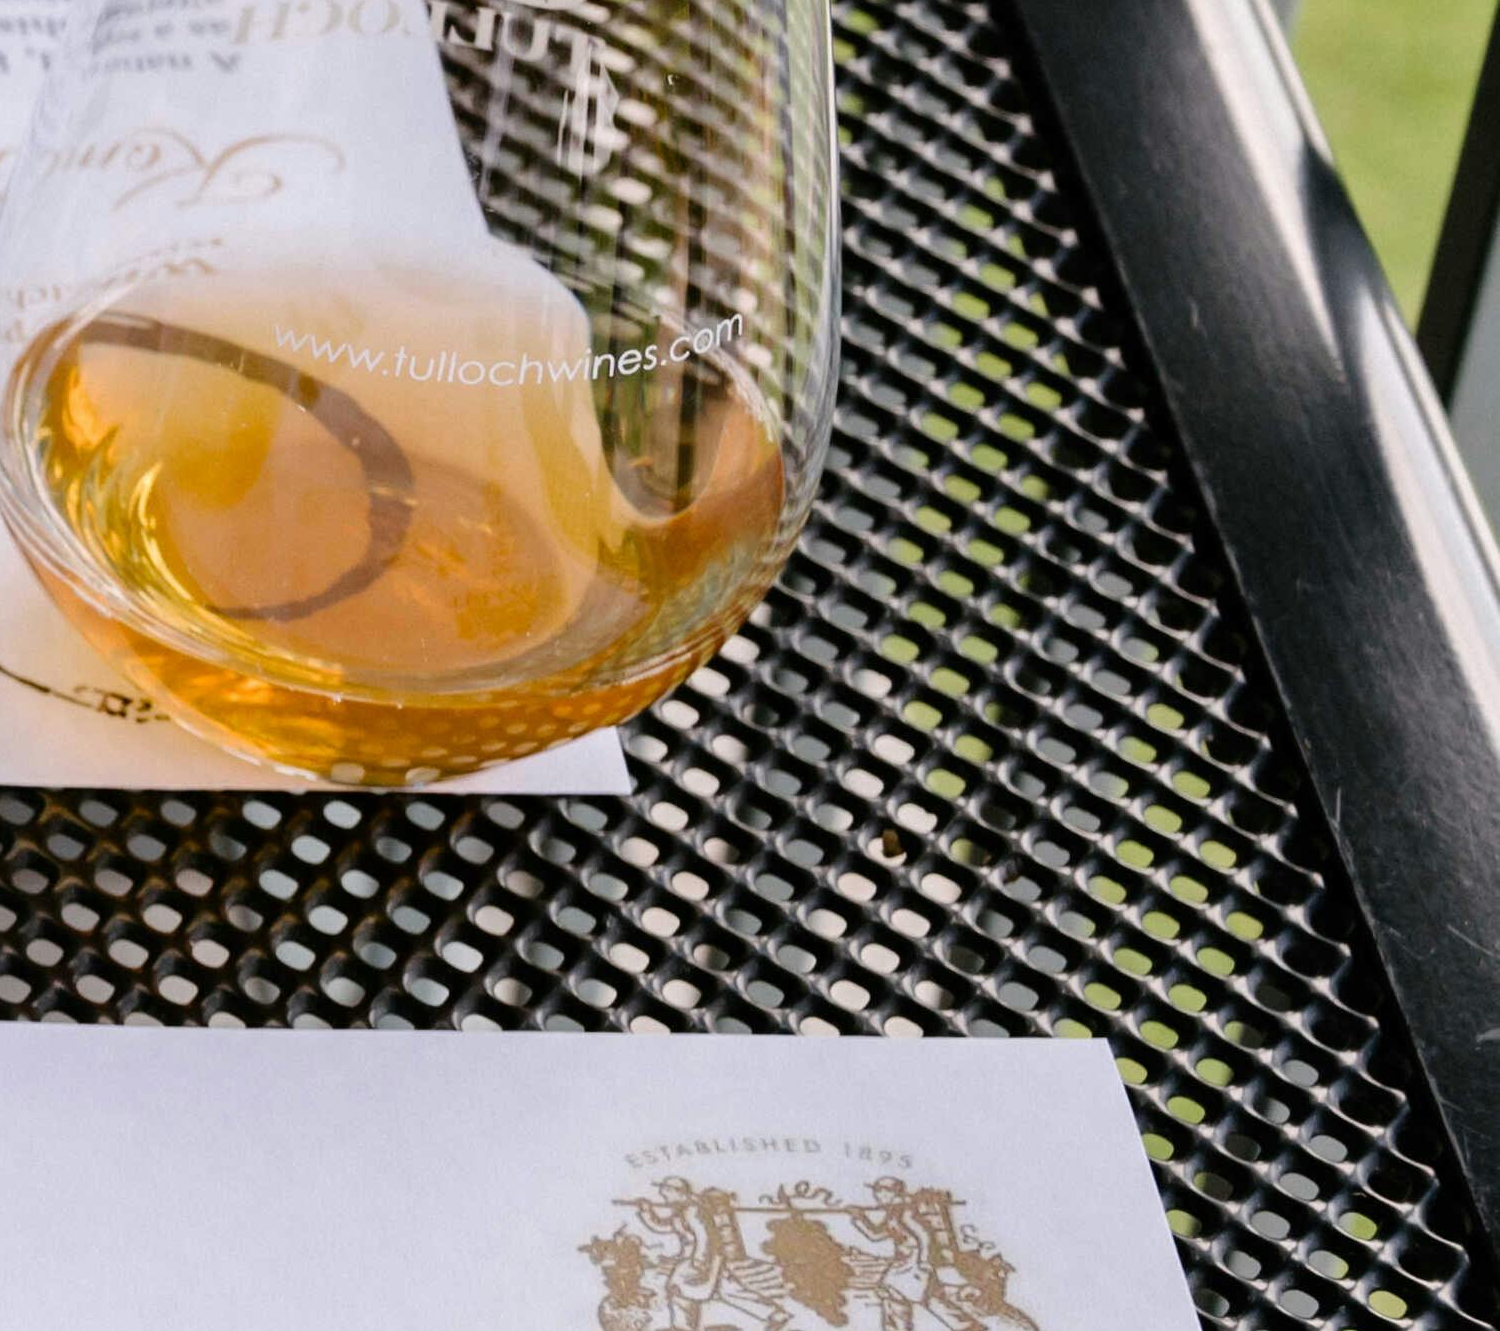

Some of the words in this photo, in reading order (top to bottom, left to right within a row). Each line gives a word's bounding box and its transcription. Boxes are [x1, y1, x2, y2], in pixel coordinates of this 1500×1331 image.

[273, 311, 746, 387] www.tullochwines.com
[623, 1135, 823, 1170] ESTABLISHED
[842, 1140, 915, 1171] 1895
